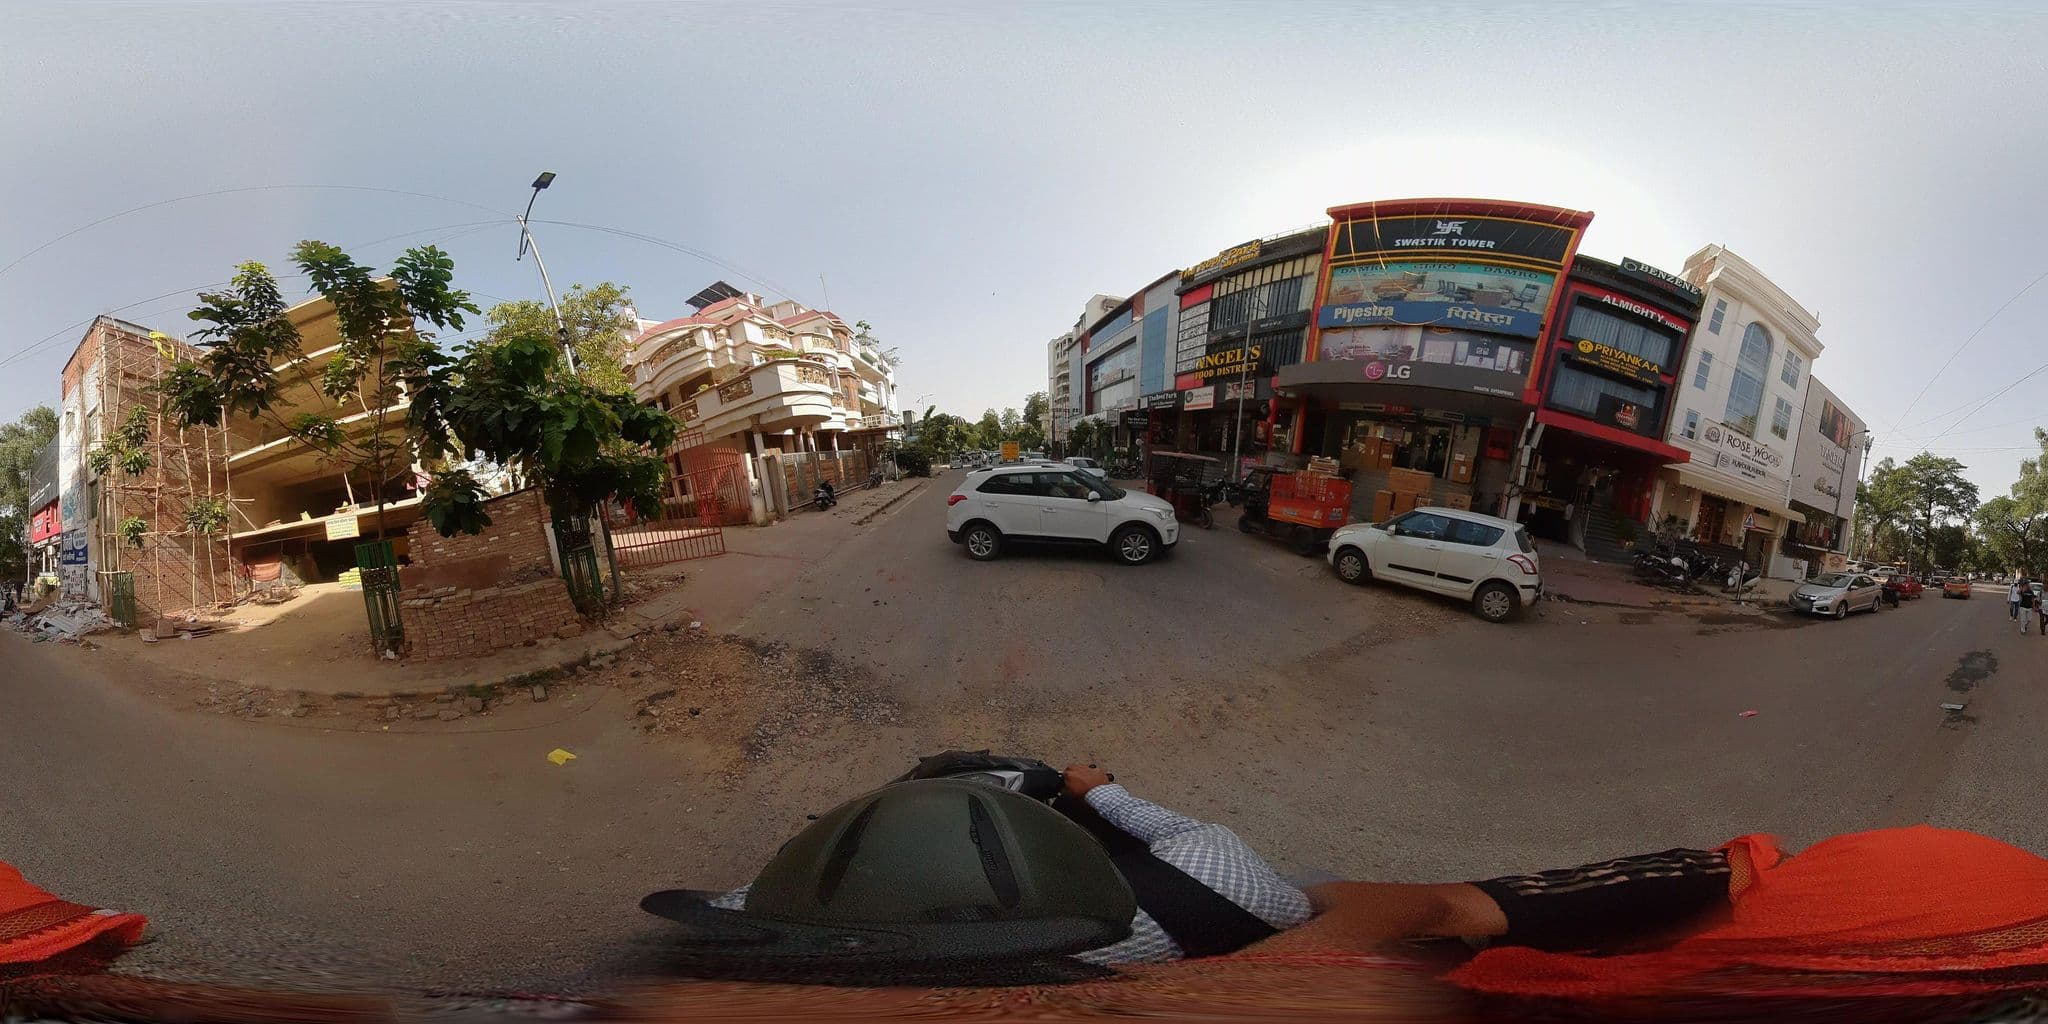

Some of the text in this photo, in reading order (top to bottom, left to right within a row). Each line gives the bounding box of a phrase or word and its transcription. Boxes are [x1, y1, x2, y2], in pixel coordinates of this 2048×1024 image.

[1394, 238, 1496, 249] SWASTIK TOWER
[1340, 264, 1390, 274] DAMRO
[1482, 265, 1539, 279] DAMRO
[1639, 262, 1699, 295] BENZENE
[1333, 305, 1394, 323] Piyestra
[1446, 306, 1516, 325] पियेस्टा
[1602, 294, 1665, 323] ALMIGHTY
[1594, 343, 1659, 374] PRIYANKAA
[1194, 362, 1258, 379] FOOD DISTRICT
[1386, 364, 1411, 378] LG
[1726, 434, 1751, 453] ROSE
